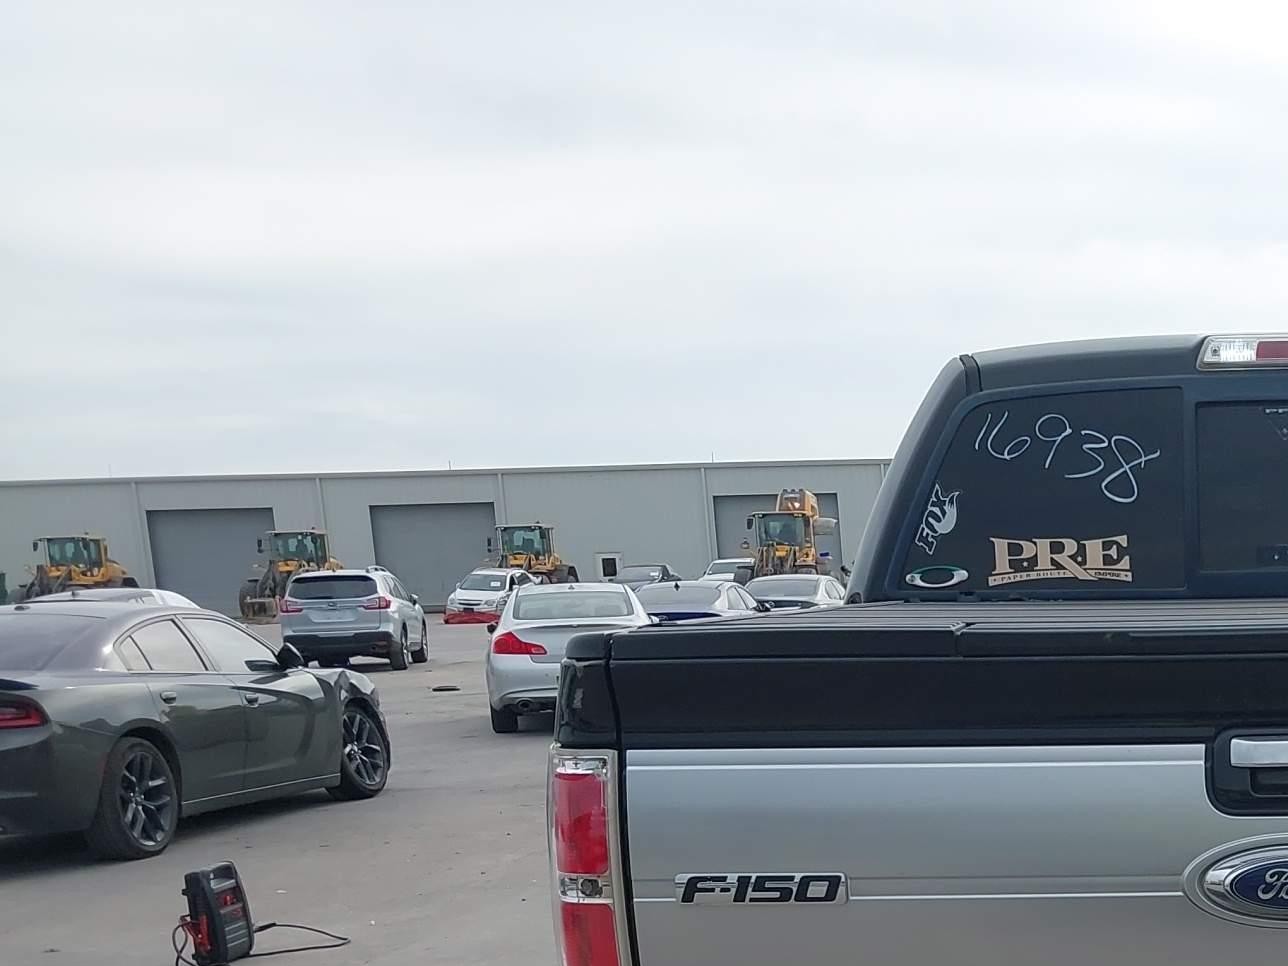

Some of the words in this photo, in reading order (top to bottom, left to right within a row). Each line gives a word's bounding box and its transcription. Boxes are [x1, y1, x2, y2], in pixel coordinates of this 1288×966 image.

[975, 410, 1161, 503] 16938
[915, 482, 960, 555] FOX
[680, 875, 843, 904] F-150
